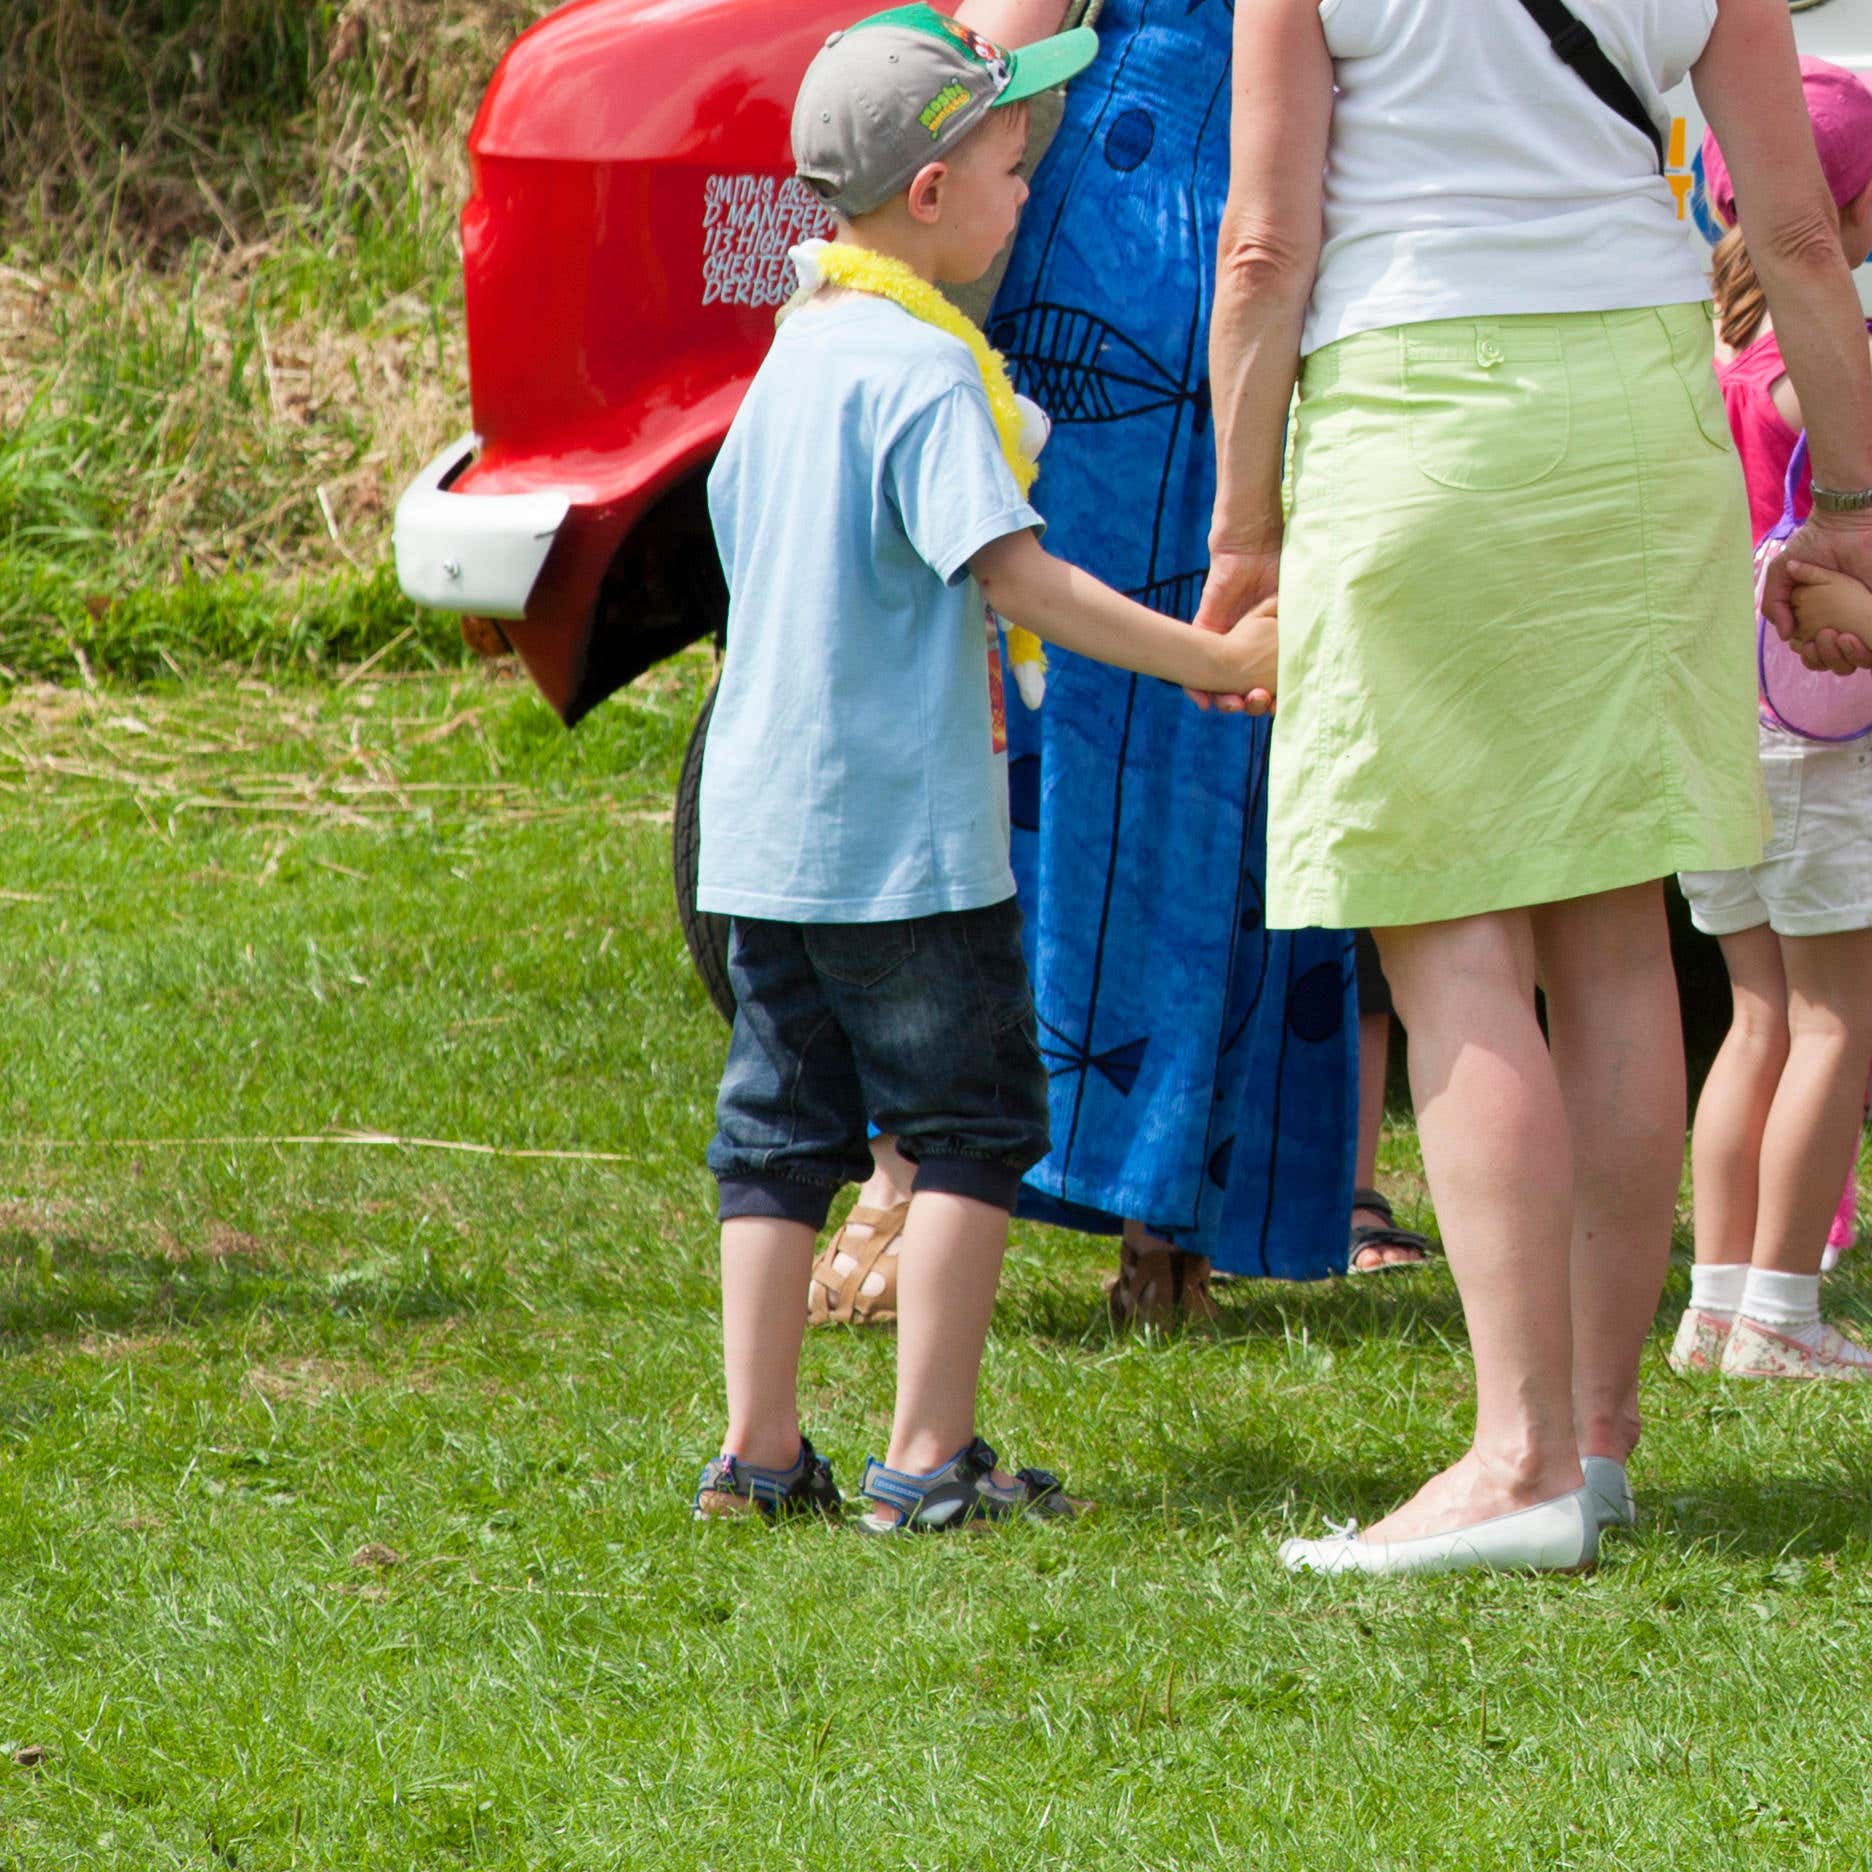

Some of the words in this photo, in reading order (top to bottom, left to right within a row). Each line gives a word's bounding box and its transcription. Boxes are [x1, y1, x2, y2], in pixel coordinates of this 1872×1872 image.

[704, 174, 776, 205] SMITHS
[737, 226, 793, 258] HIGH
[703, 252, 798, 282] CHESTER
[701, 277, 800, 308] DERBYS
